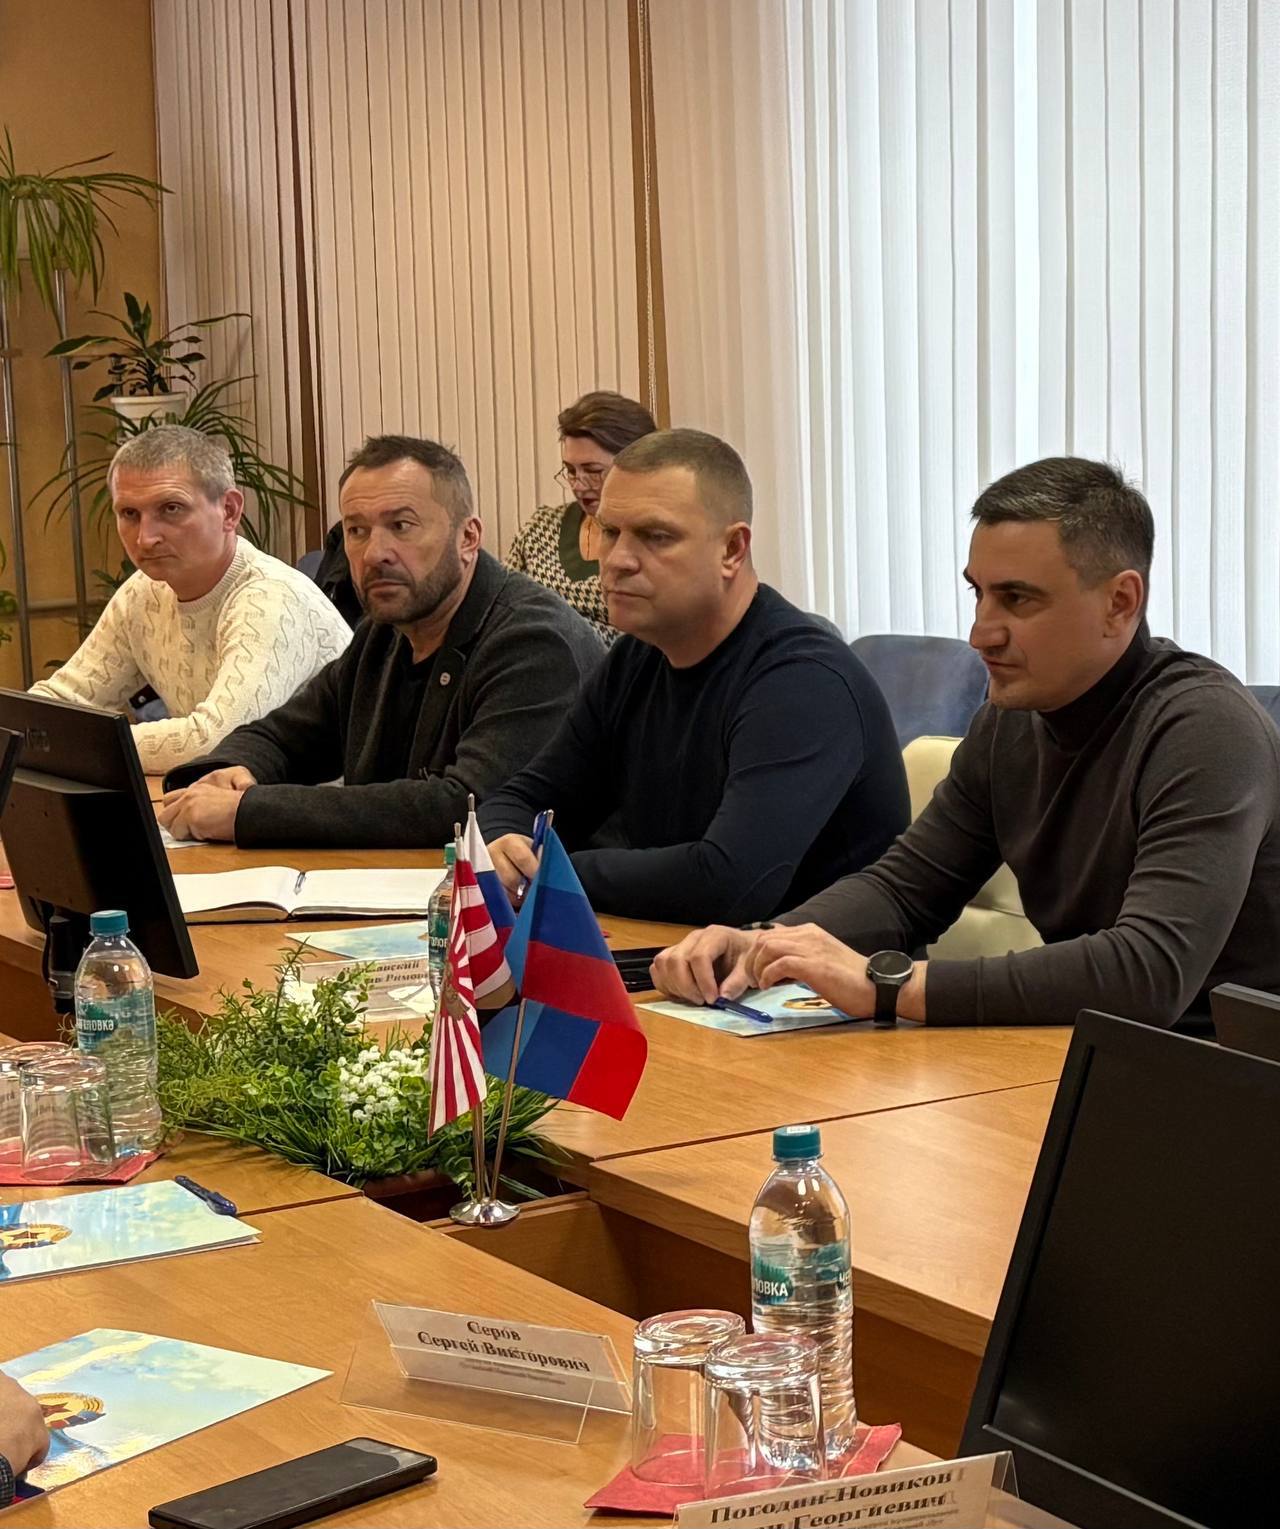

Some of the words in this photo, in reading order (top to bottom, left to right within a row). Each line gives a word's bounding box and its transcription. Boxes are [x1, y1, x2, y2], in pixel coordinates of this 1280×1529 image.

[466, 1320, 522, 1341] Серов
[417, 1331, 479, 1353] Сергей
[483, 1341, 592, 1372] Викторович
[711, 1471, 952, 1524] Погодин-Новиков
